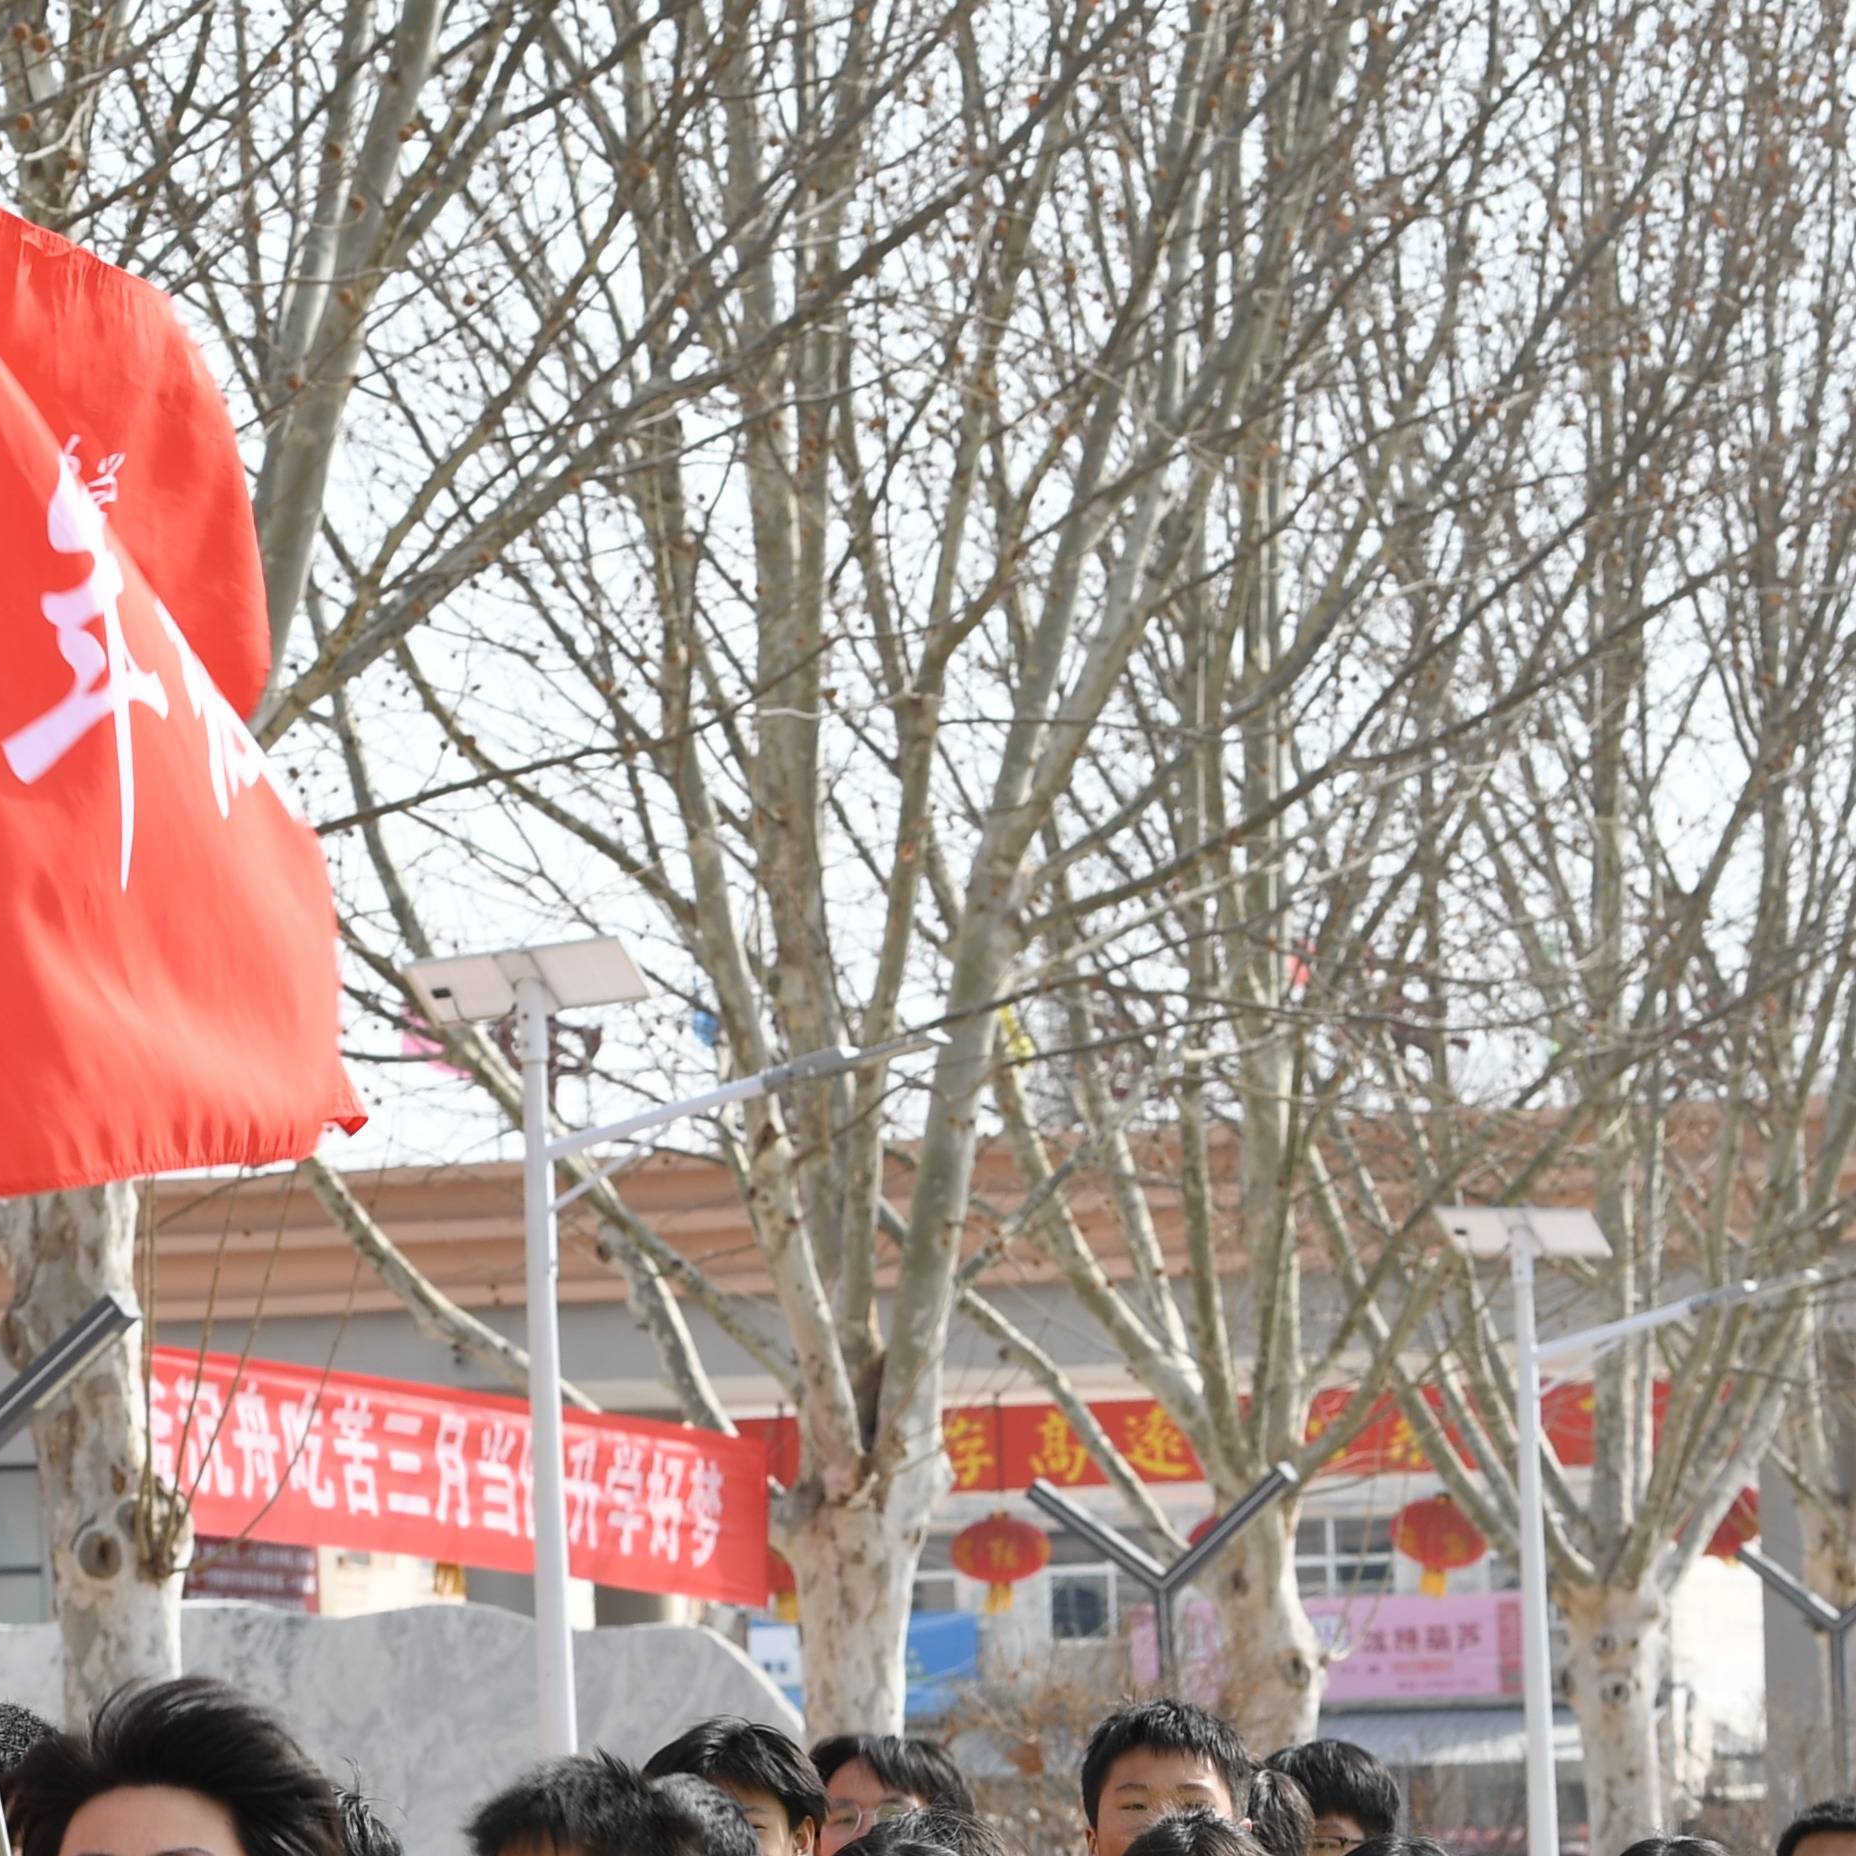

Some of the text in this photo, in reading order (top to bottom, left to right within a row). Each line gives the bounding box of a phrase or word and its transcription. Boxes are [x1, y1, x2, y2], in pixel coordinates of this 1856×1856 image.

[148, 1374, 724, 1568] 釜沉舟吃苦三月当升学好梦
